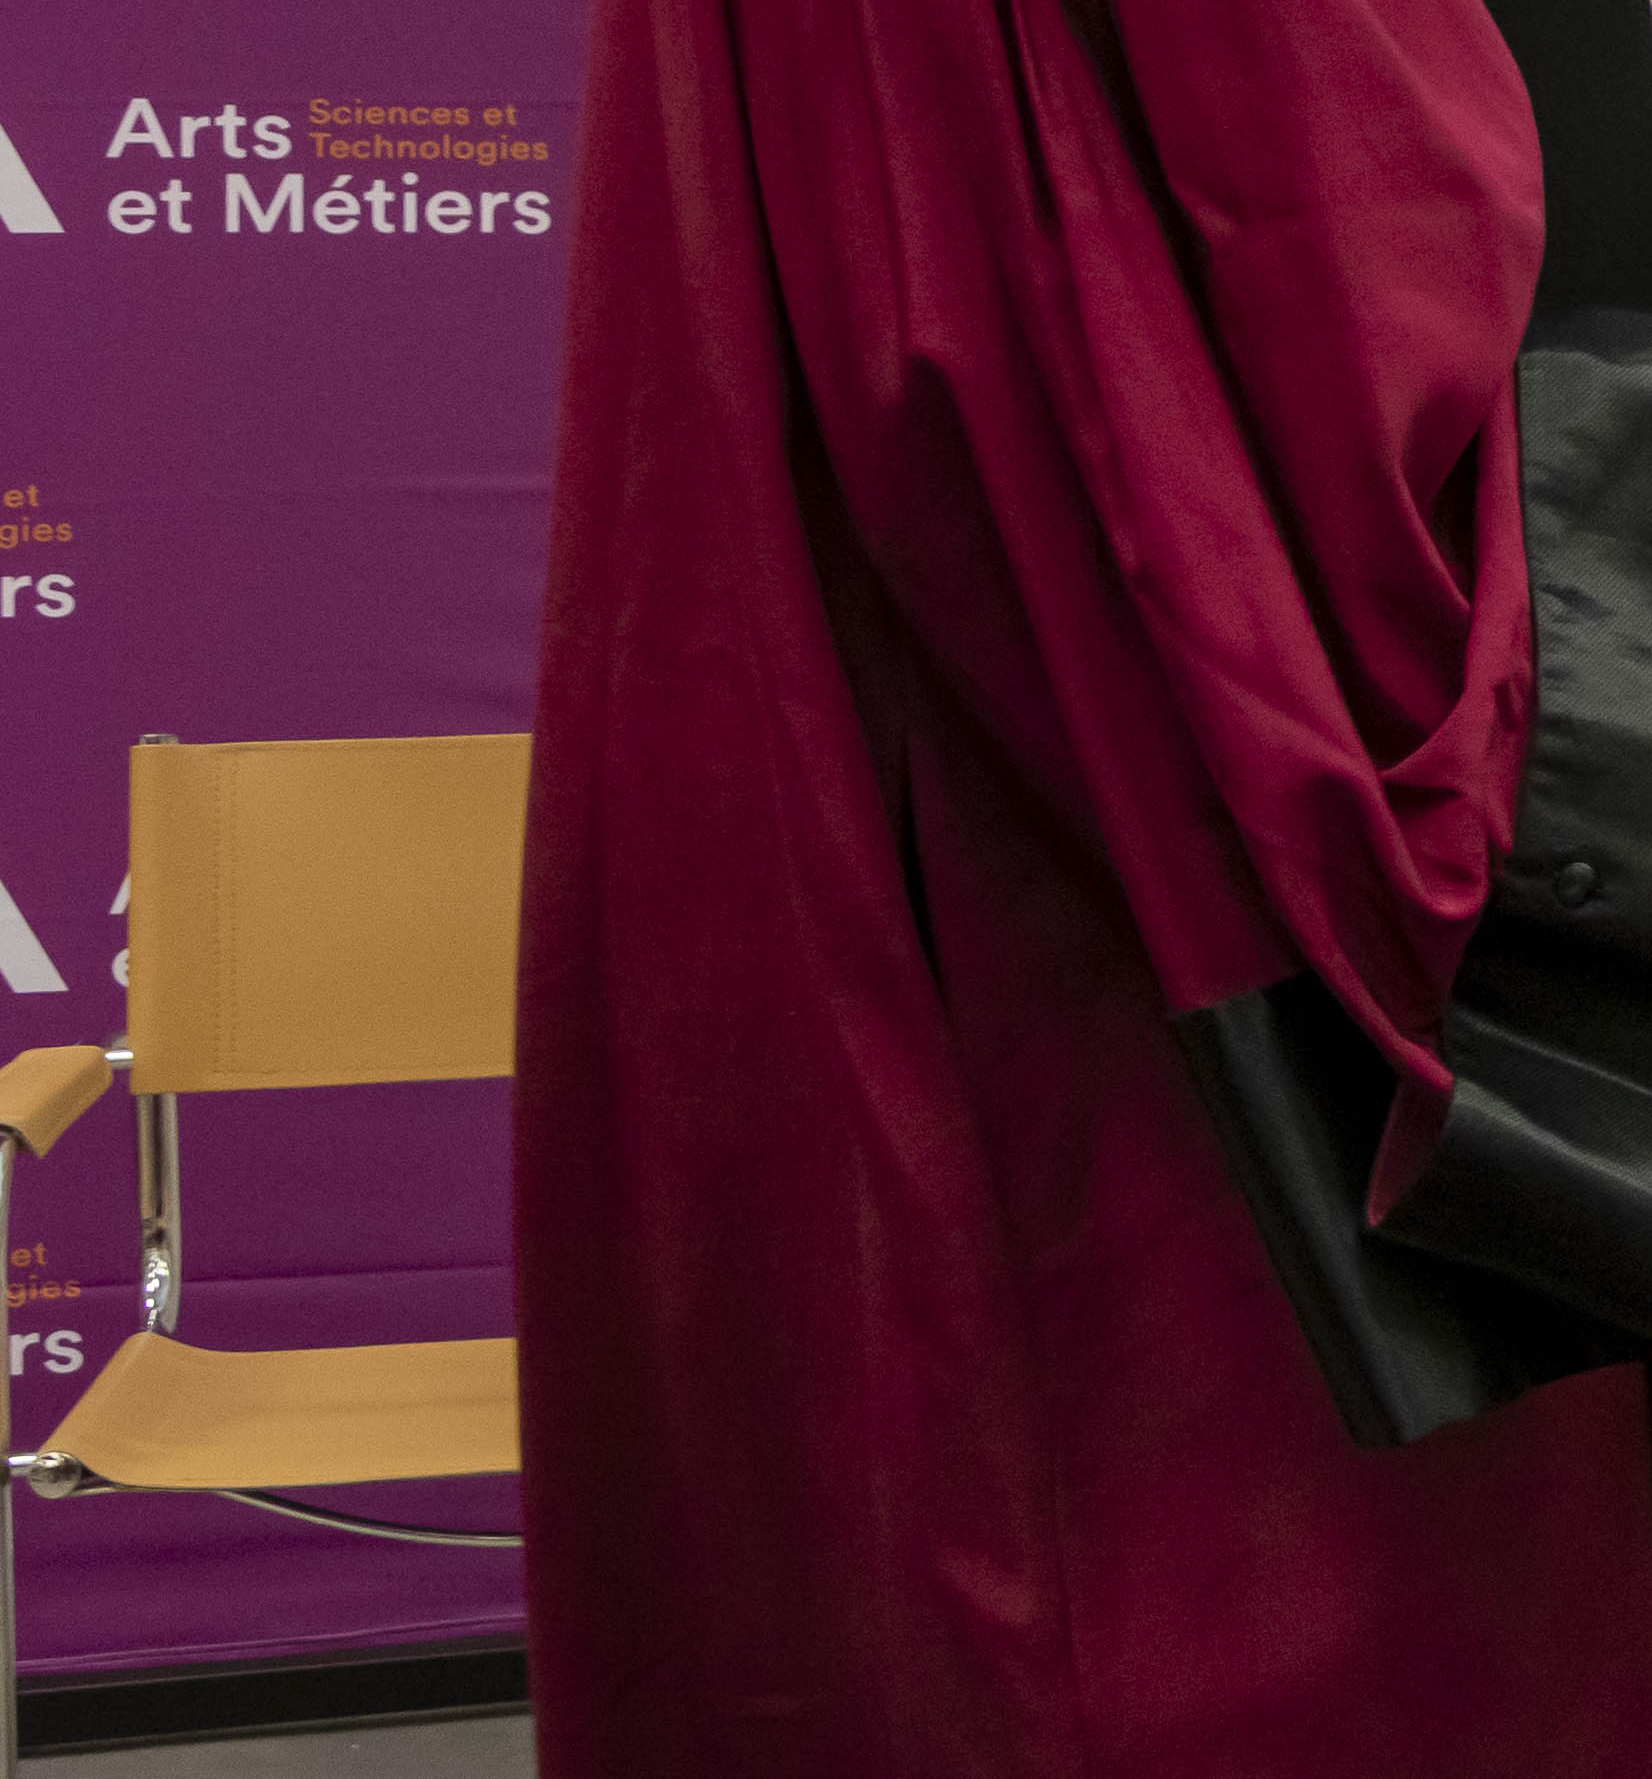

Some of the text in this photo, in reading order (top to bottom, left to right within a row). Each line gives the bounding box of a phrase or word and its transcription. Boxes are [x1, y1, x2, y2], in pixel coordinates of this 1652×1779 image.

[309, 98, 517, 126] Sciences et
[107, 98, 292, 159] Arts
[309, 132, 549, 166] Technologies
[107, 172, 552, 234] et Métiers
[3, 484, 39, 508] et
[10, 1242, 47, 1267] et
